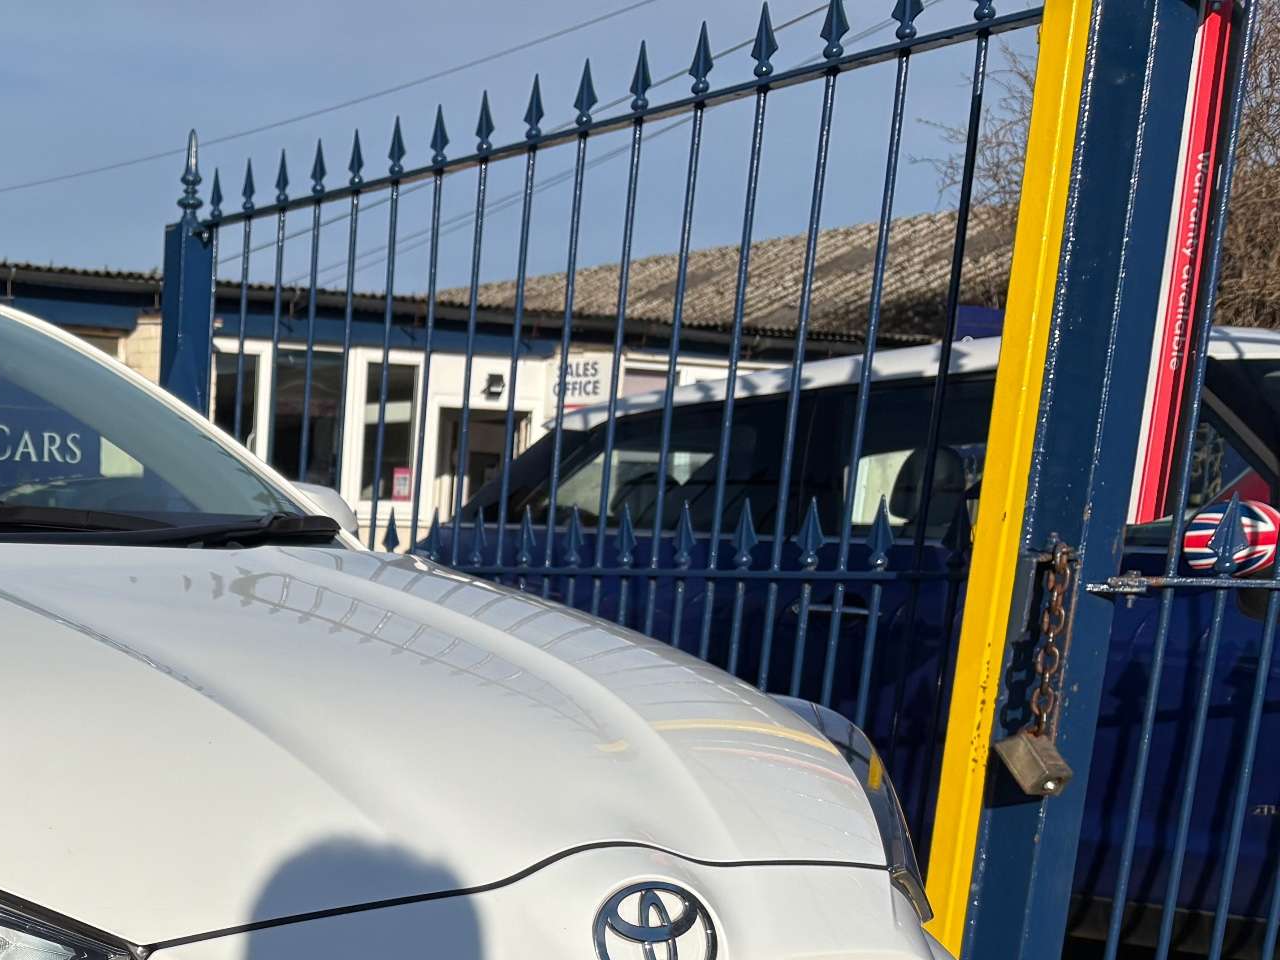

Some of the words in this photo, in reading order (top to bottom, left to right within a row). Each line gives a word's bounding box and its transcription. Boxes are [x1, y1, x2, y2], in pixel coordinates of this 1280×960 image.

[1182, 151, 1210, 257] Warranty
[558, 360, 599, 378] ALES
[1169, 264, 1193, 370] available
